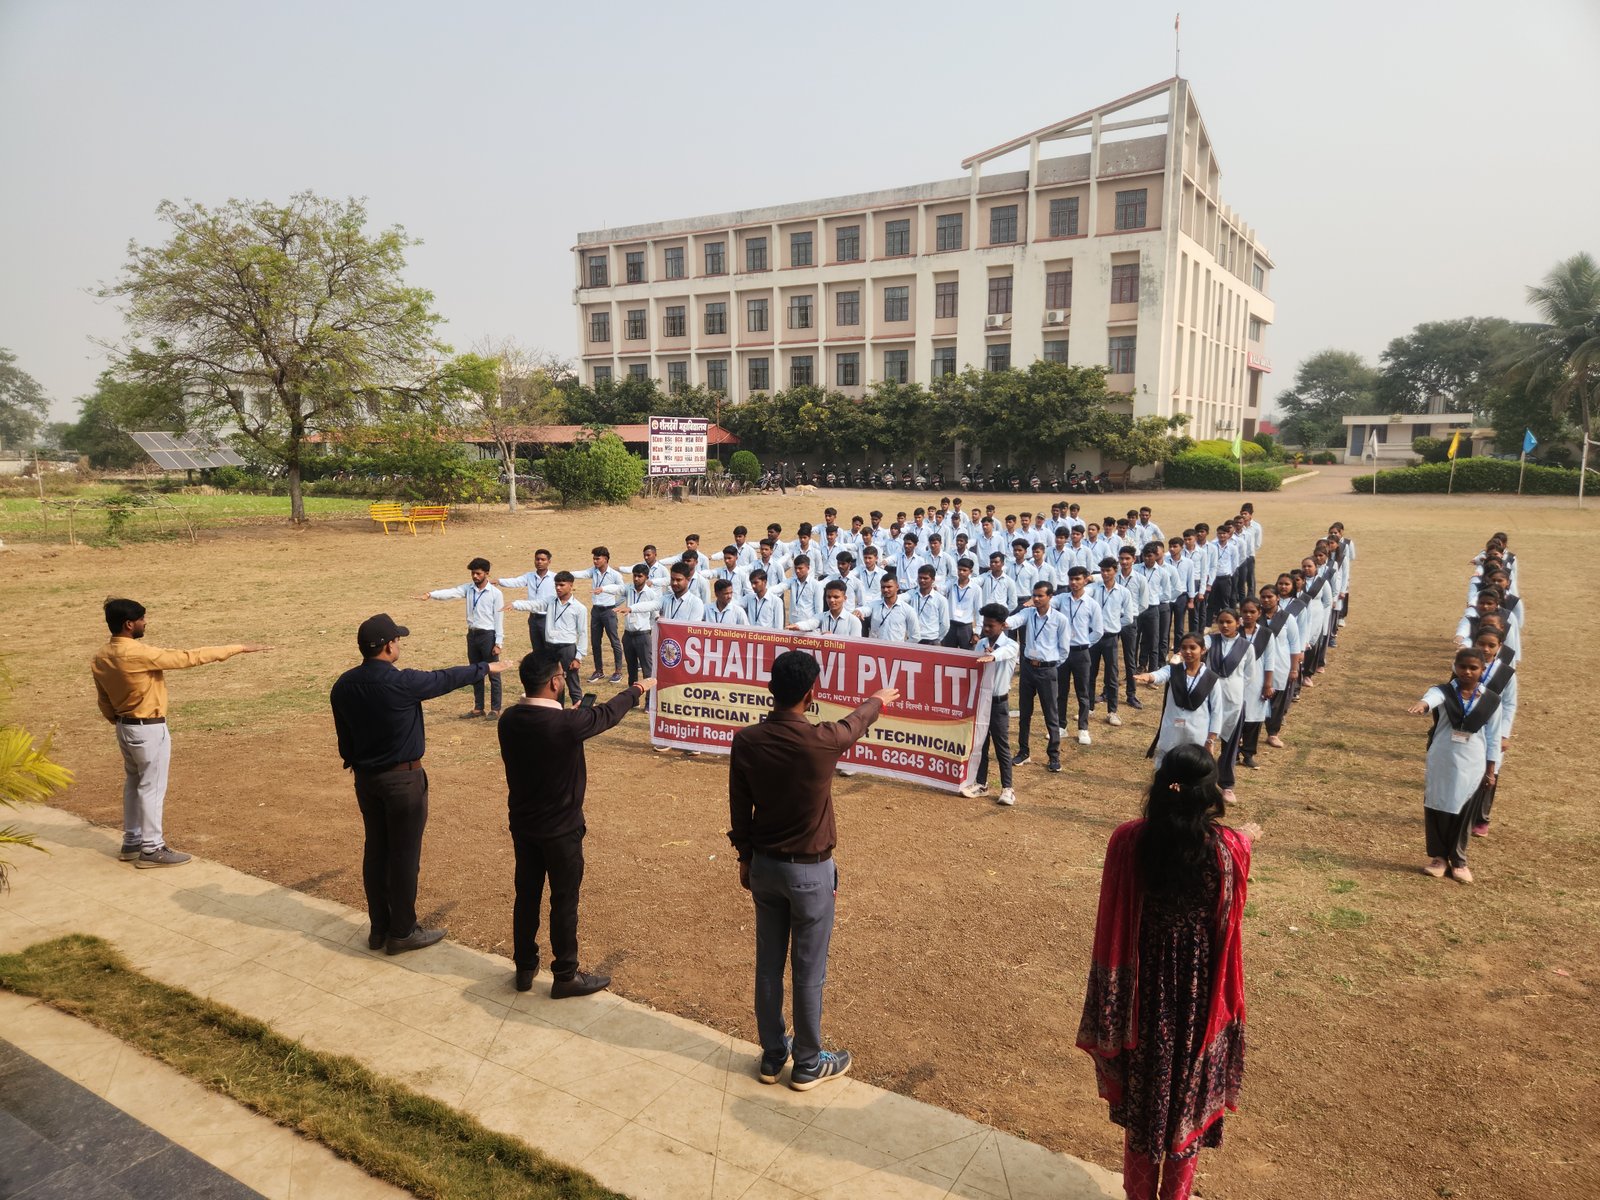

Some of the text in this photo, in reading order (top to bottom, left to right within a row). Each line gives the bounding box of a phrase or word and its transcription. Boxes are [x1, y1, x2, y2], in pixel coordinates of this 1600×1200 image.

[704, 628, 712, 636] by
[714, 629, 746, 639] Shaildevi
[748, 633, 791, 644] Educational
[793, 637, 822, 648] Society,
[824, 640, 846, 650] Bhilai
[684, 636, 846, 692] SHAILVI
[857, 654, 922, 700] PVT
[934, 664, 978, 710] ITI
[684, 686, 720, 702] COPA
[661, 702, 750, 723] ELECTRICIAN
[906, 702, 922, 712] दिल्ली
[924, 704, 930, 712] से
[658, 720, 734, 742] Janjgiri Road
[874, 728, 966, 756] TECHNICIAN
[856, 744, 878, 760] Ph.
[882, 748, 924, 768] 62645
